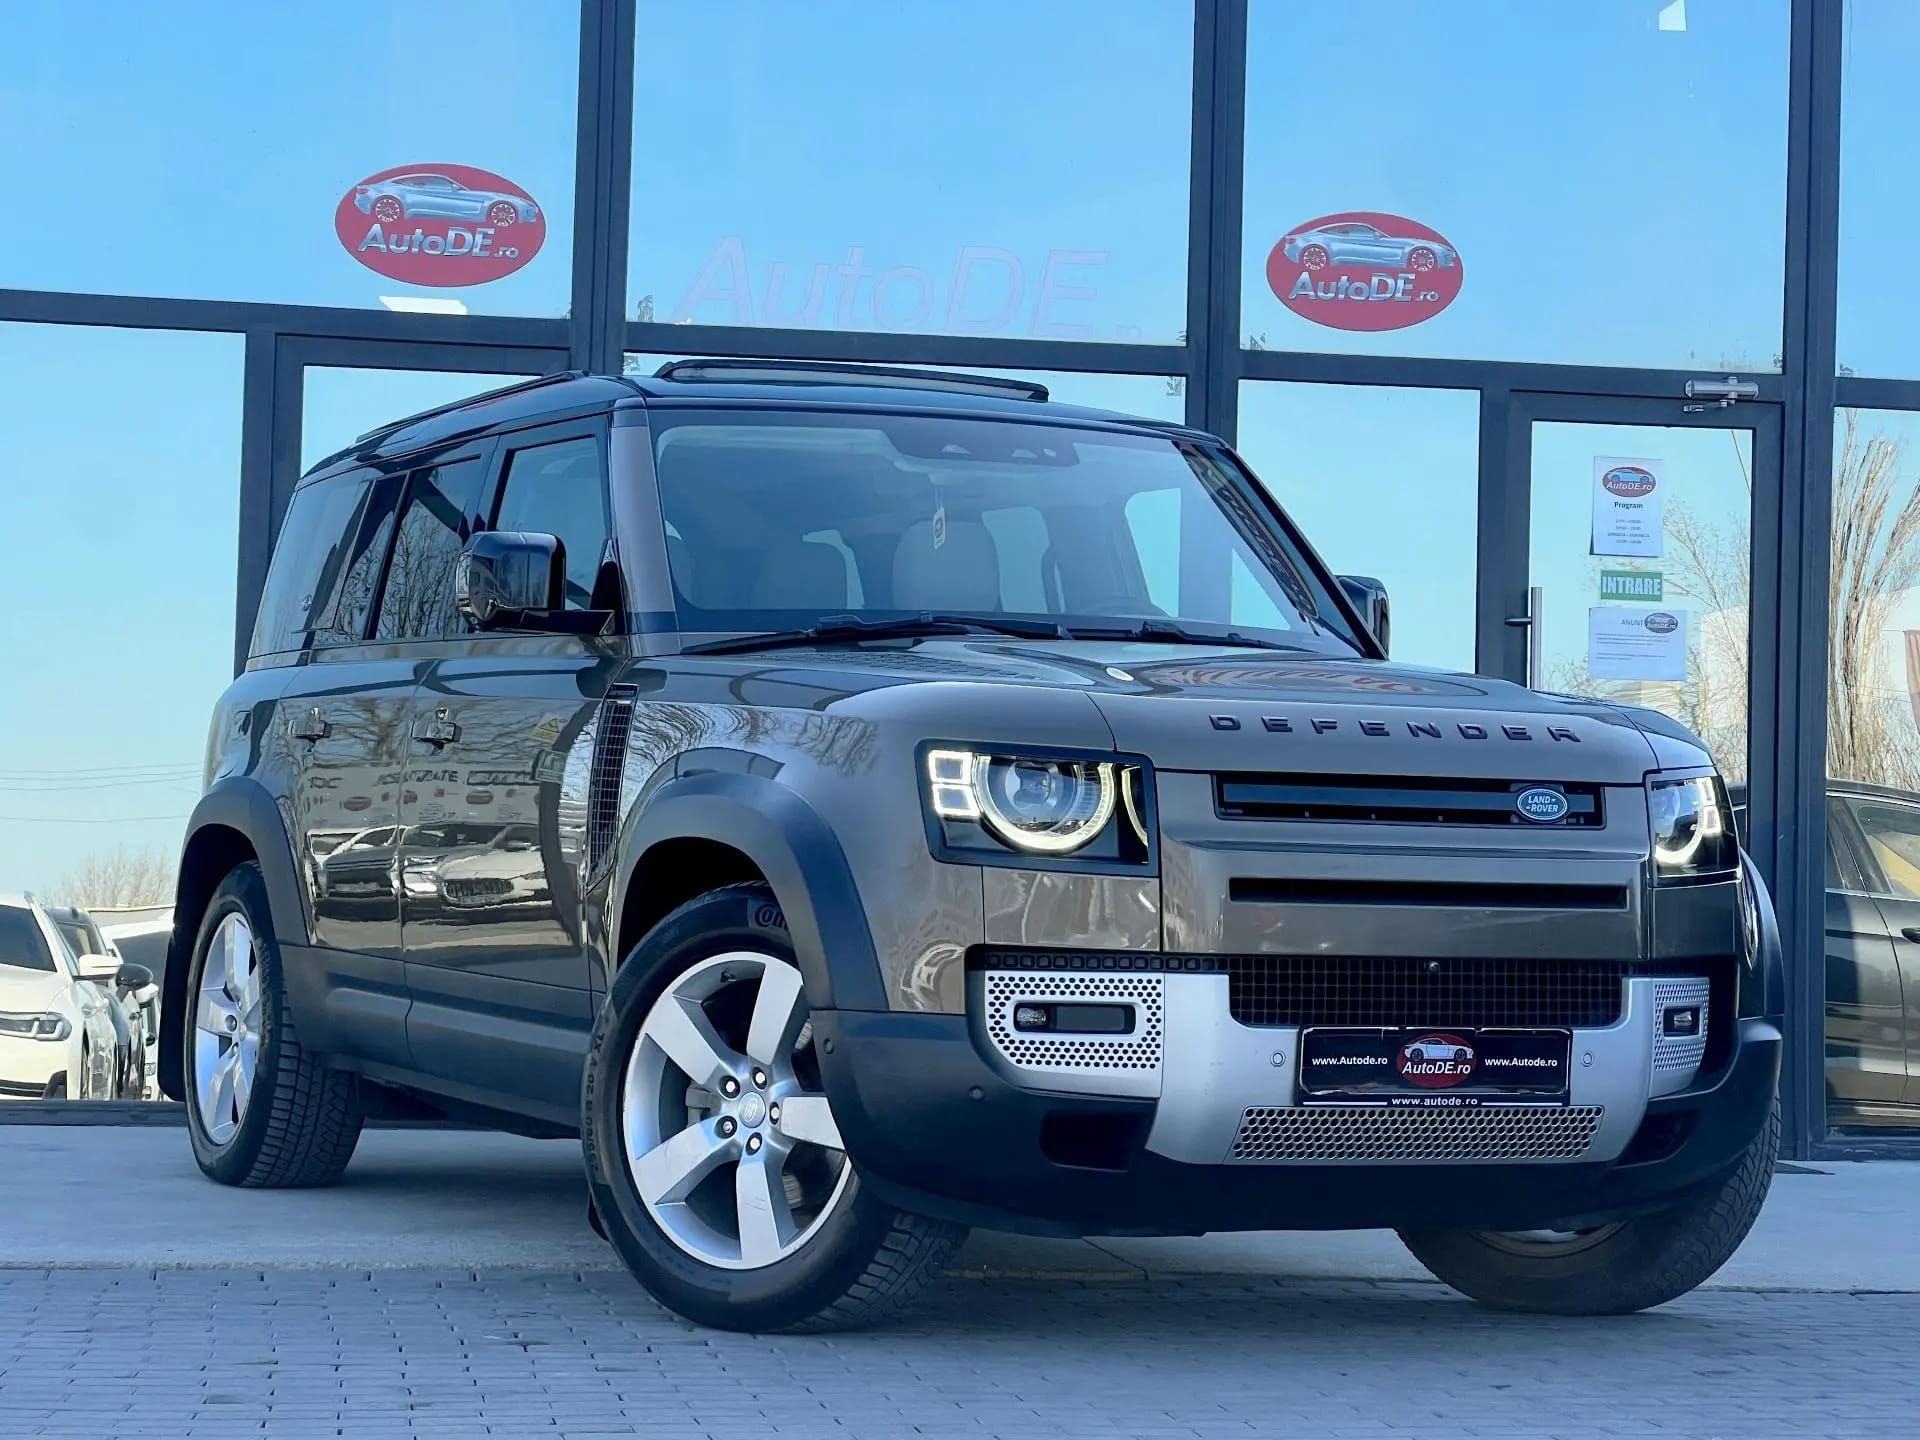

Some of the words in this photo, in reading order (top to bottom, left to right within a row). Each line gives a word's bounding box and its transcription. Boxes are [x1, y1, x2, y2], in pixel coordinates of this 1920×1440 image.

[358, 223, 520, 258] AutoDE.ro
[1288, 271, 1440, 302] AutoDE.ro
[1606, 481, 1653, 491] AutoDE.ro
[1614, 501, 1643, 510] Program
[1602, 576, 1661, 595] INTRARE
[1208, 713, 1582, 743] DEFENDER
[1312, 1056, 1388, 1066] www.Autode.ro
[1485, 1058, 1558, 1068] www.Autode.ro
[1402, 1062, 1471, 1075] AutoDE.ro
